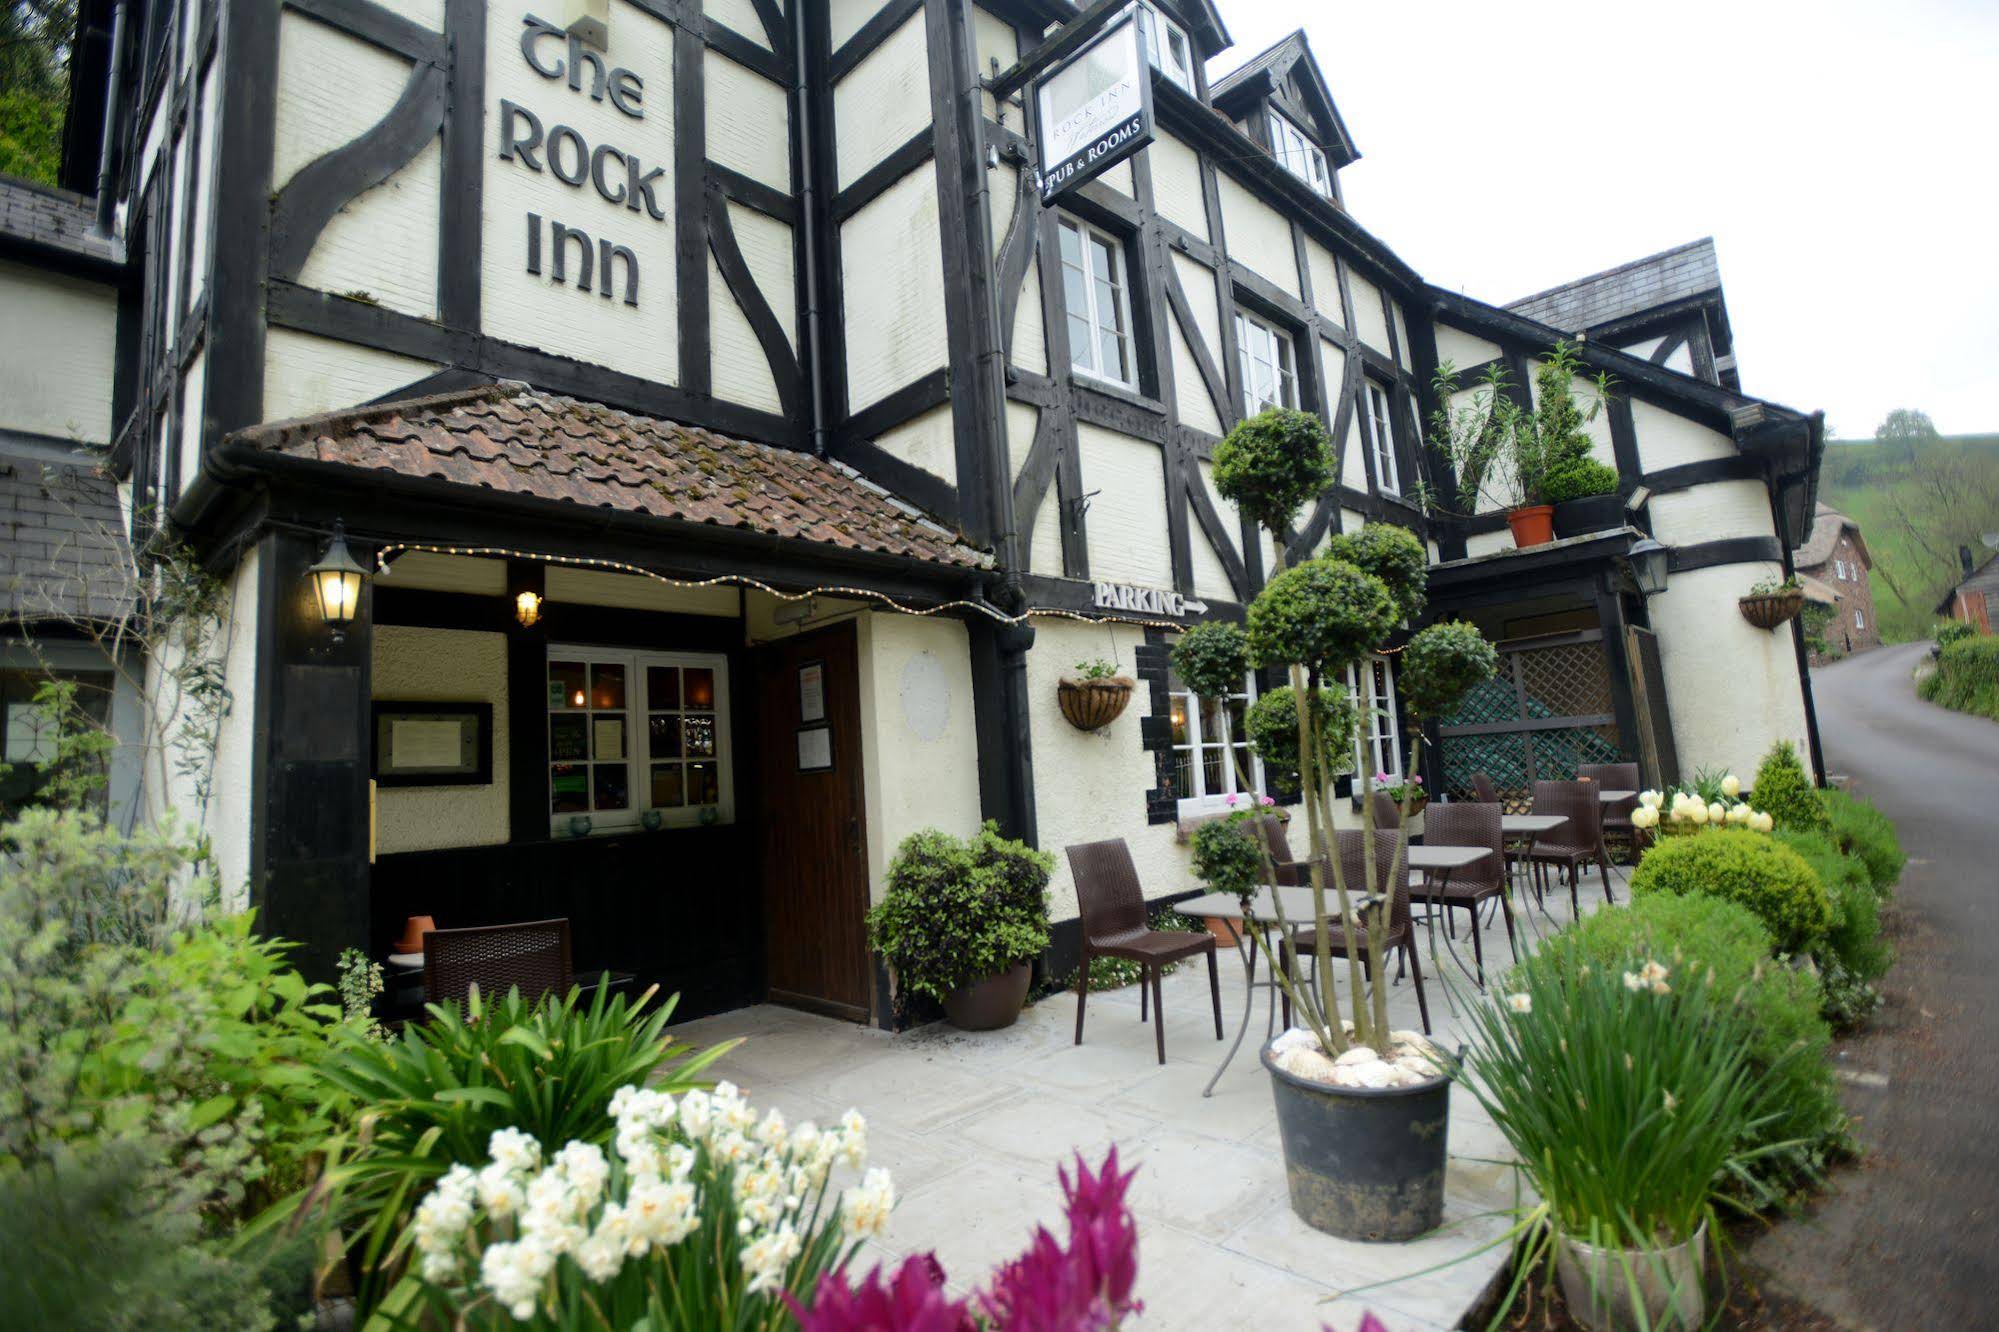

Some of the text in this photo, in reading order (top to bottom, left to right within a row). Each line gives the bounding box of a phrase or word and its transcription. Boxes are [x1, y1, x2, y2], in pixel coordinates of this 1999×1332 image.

[499, 97, 667, 221] ROCK
[1047, 162, 1075, 188] PUB
[1076, 158, 1086, 170] &
[1087, 118, 1141, 162] ROOMS
[1094, 582, 1185, 616] PARKING
